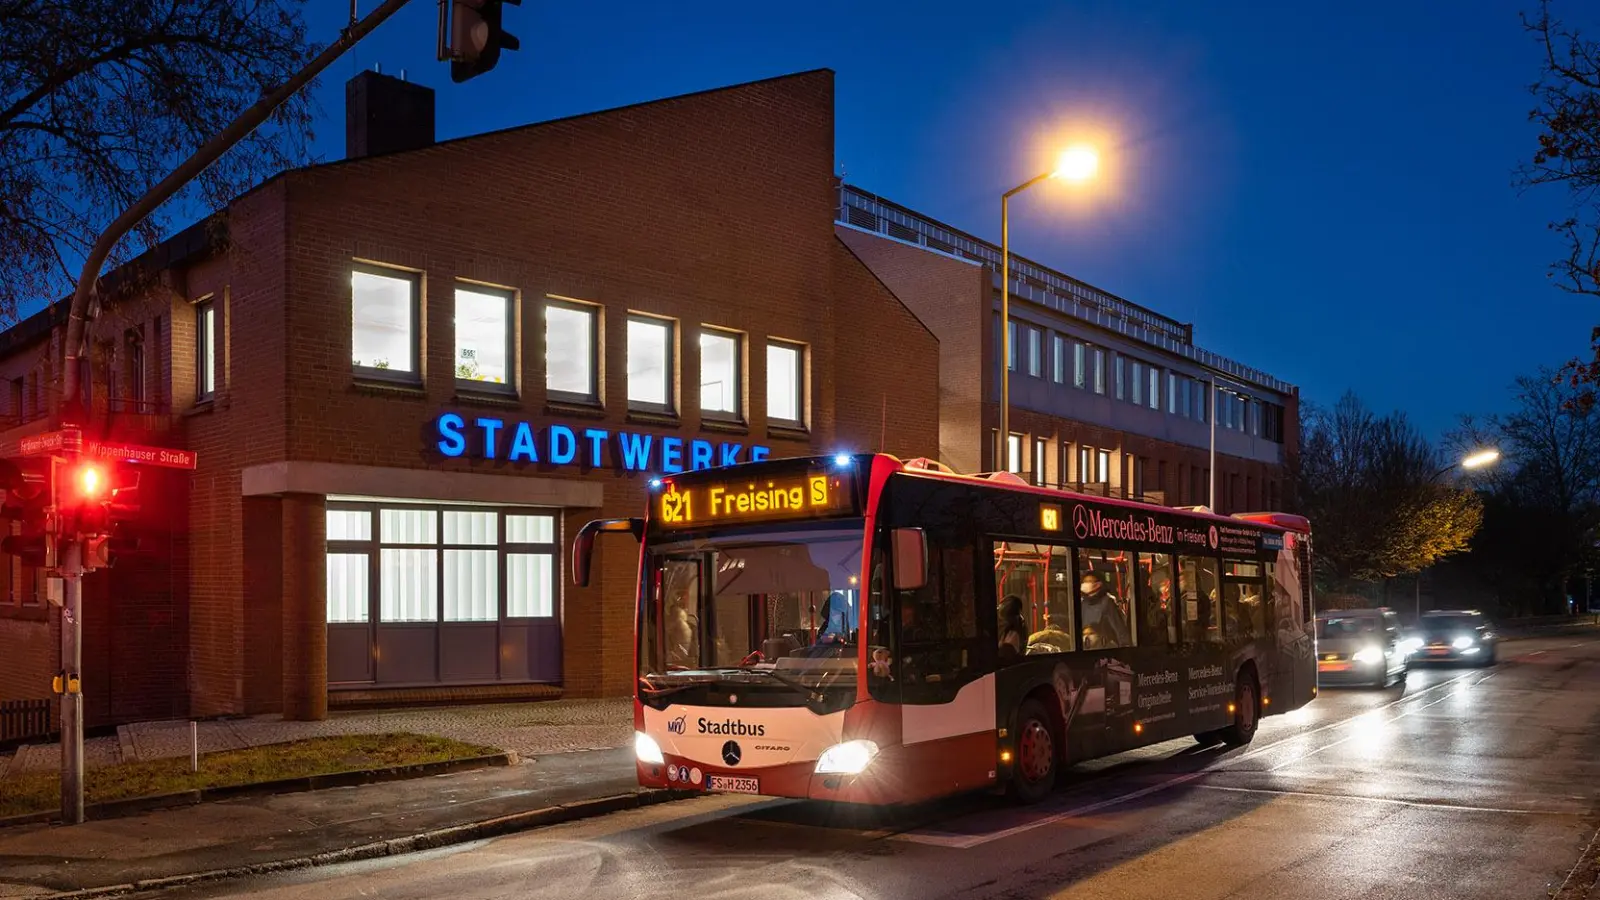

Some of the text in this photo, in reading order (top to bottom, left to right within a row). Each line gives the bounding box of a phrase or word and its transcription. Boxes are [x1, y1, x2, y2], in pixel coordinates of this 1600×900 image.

[89, 441, 190, 464] Wippenhauser Straße
[661, 478, 826, 522] 621 Freising S
[1088, 508, 1174, 544] Mercedes-Benz
[1184, 528, 1207, 547] Freising
[1137, 670, 1178, 687] Mercedes-Benz
[698, 717, 765, 736] Stadtbus
[735, 779, 758, 791] 2356
